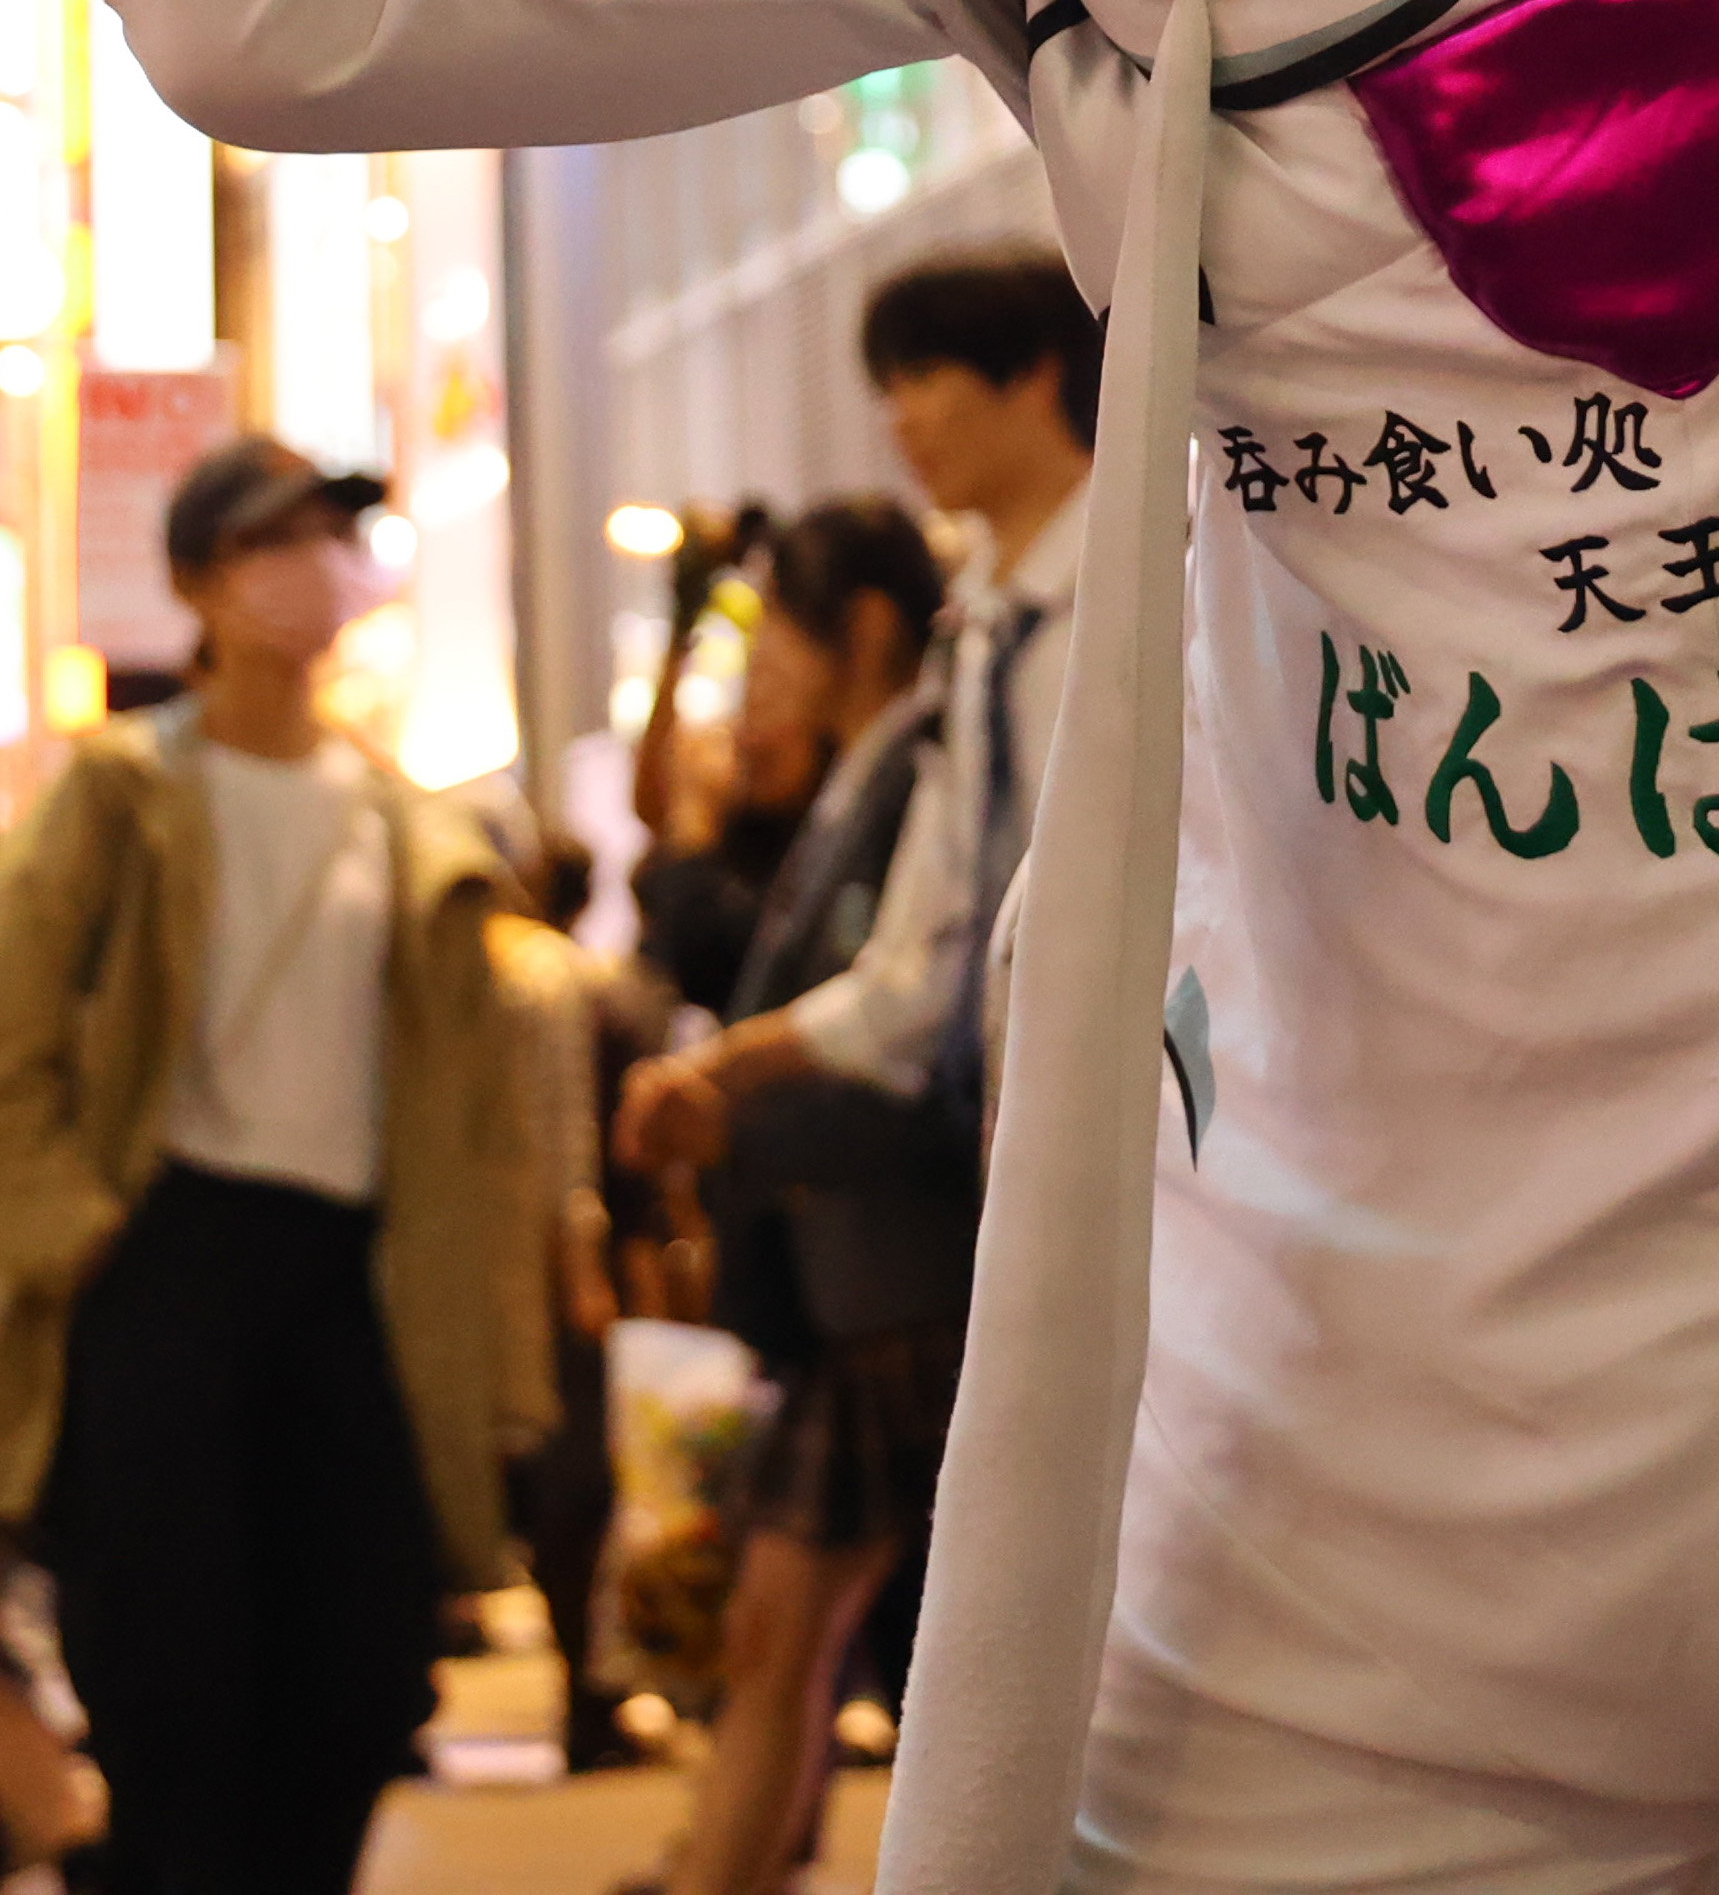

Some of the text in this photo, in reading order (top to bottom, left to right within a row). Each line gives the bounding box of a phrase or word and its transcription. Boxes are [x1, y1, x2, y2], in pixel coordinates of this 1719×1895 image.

[1218, 392, 1662, 515] 呑み食い処
